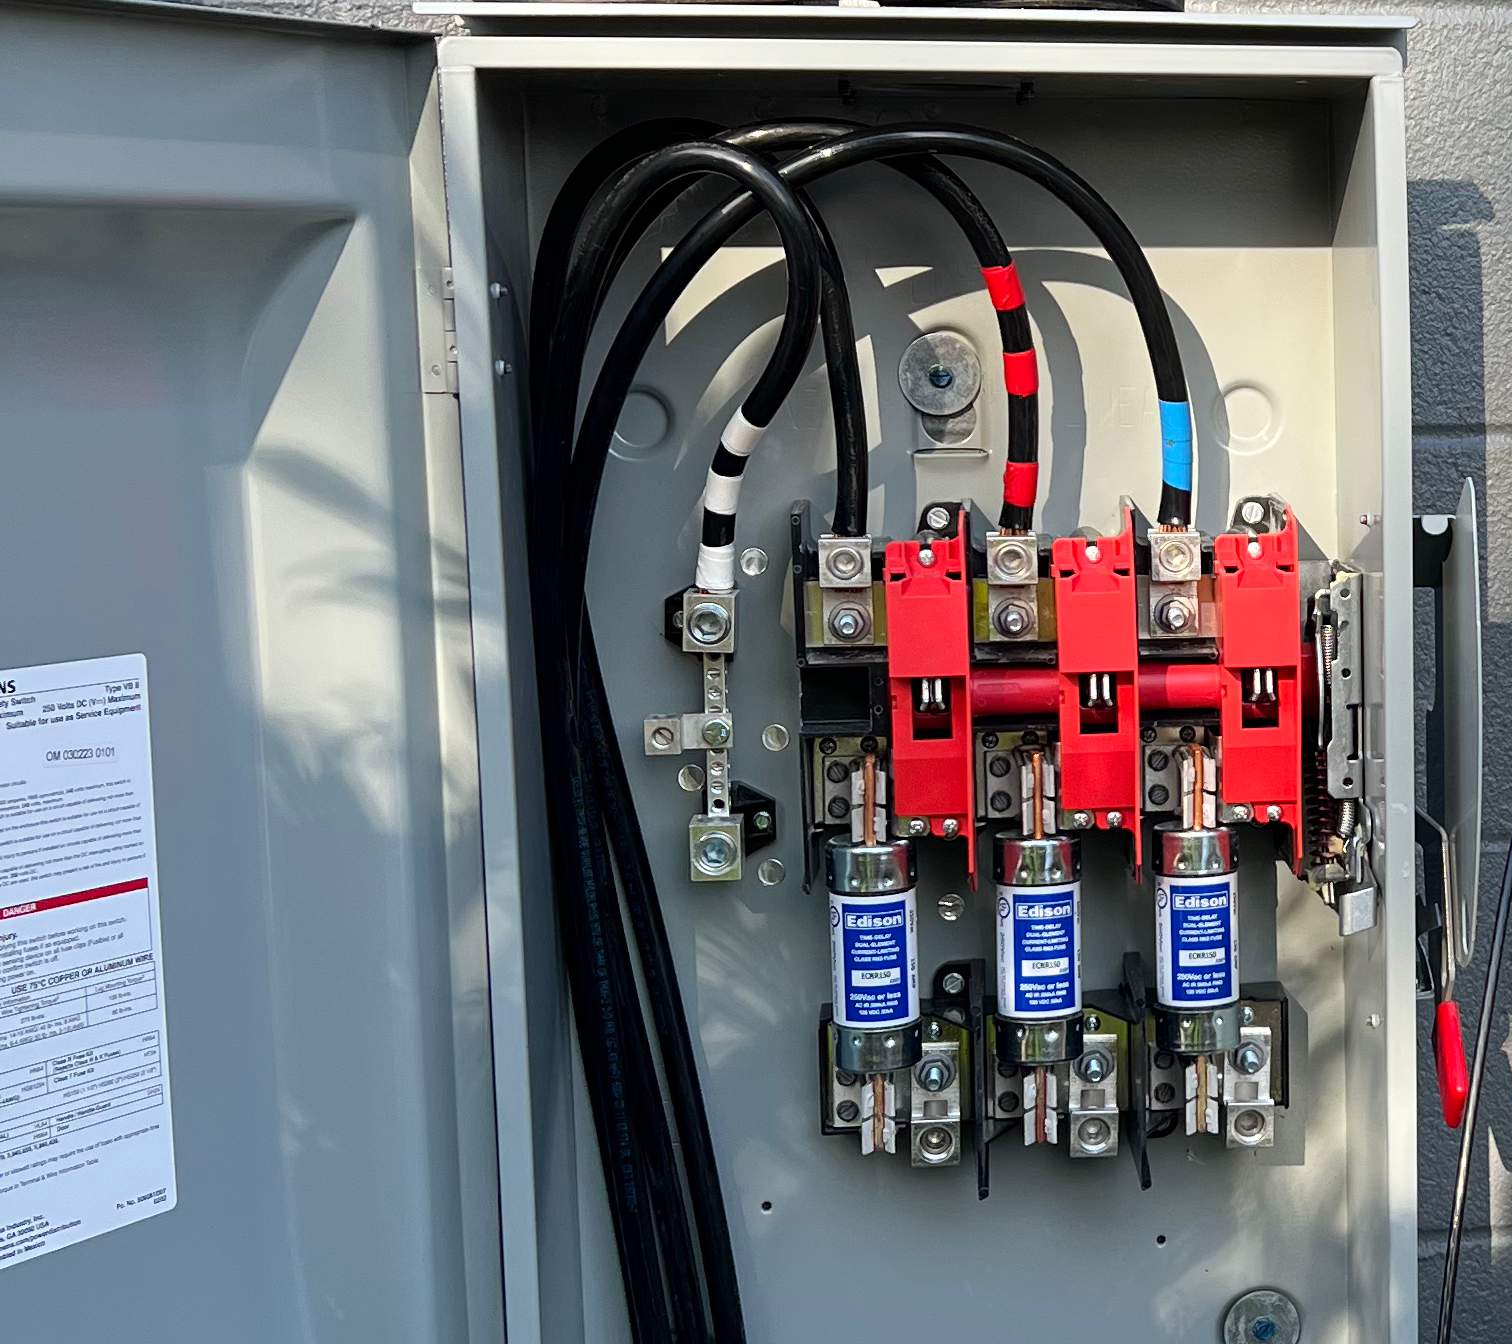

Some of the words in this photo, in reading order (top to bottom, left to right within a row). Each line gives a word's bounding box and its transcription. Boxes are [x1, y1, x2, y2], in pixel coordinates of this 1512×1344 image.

[11, 695, 36, 706] Switch
[6, 719, 37, 730] Suitable
[38, 716, 49, 724] for
[76, 709, 102, 720] Service
[104, 703, 142, 716] Equipment
[3, 902, 36, 916] DANGER
[1174, 896, 1227, 908] Edison
[1018, 906, 1070, 918] Edison
[847, 914, 902, 928] Edison
[11, 983, 27, 994] USE
[48, 970, 80, 984] COPPER
[94, 957, 134, 973] ALUMINUM
